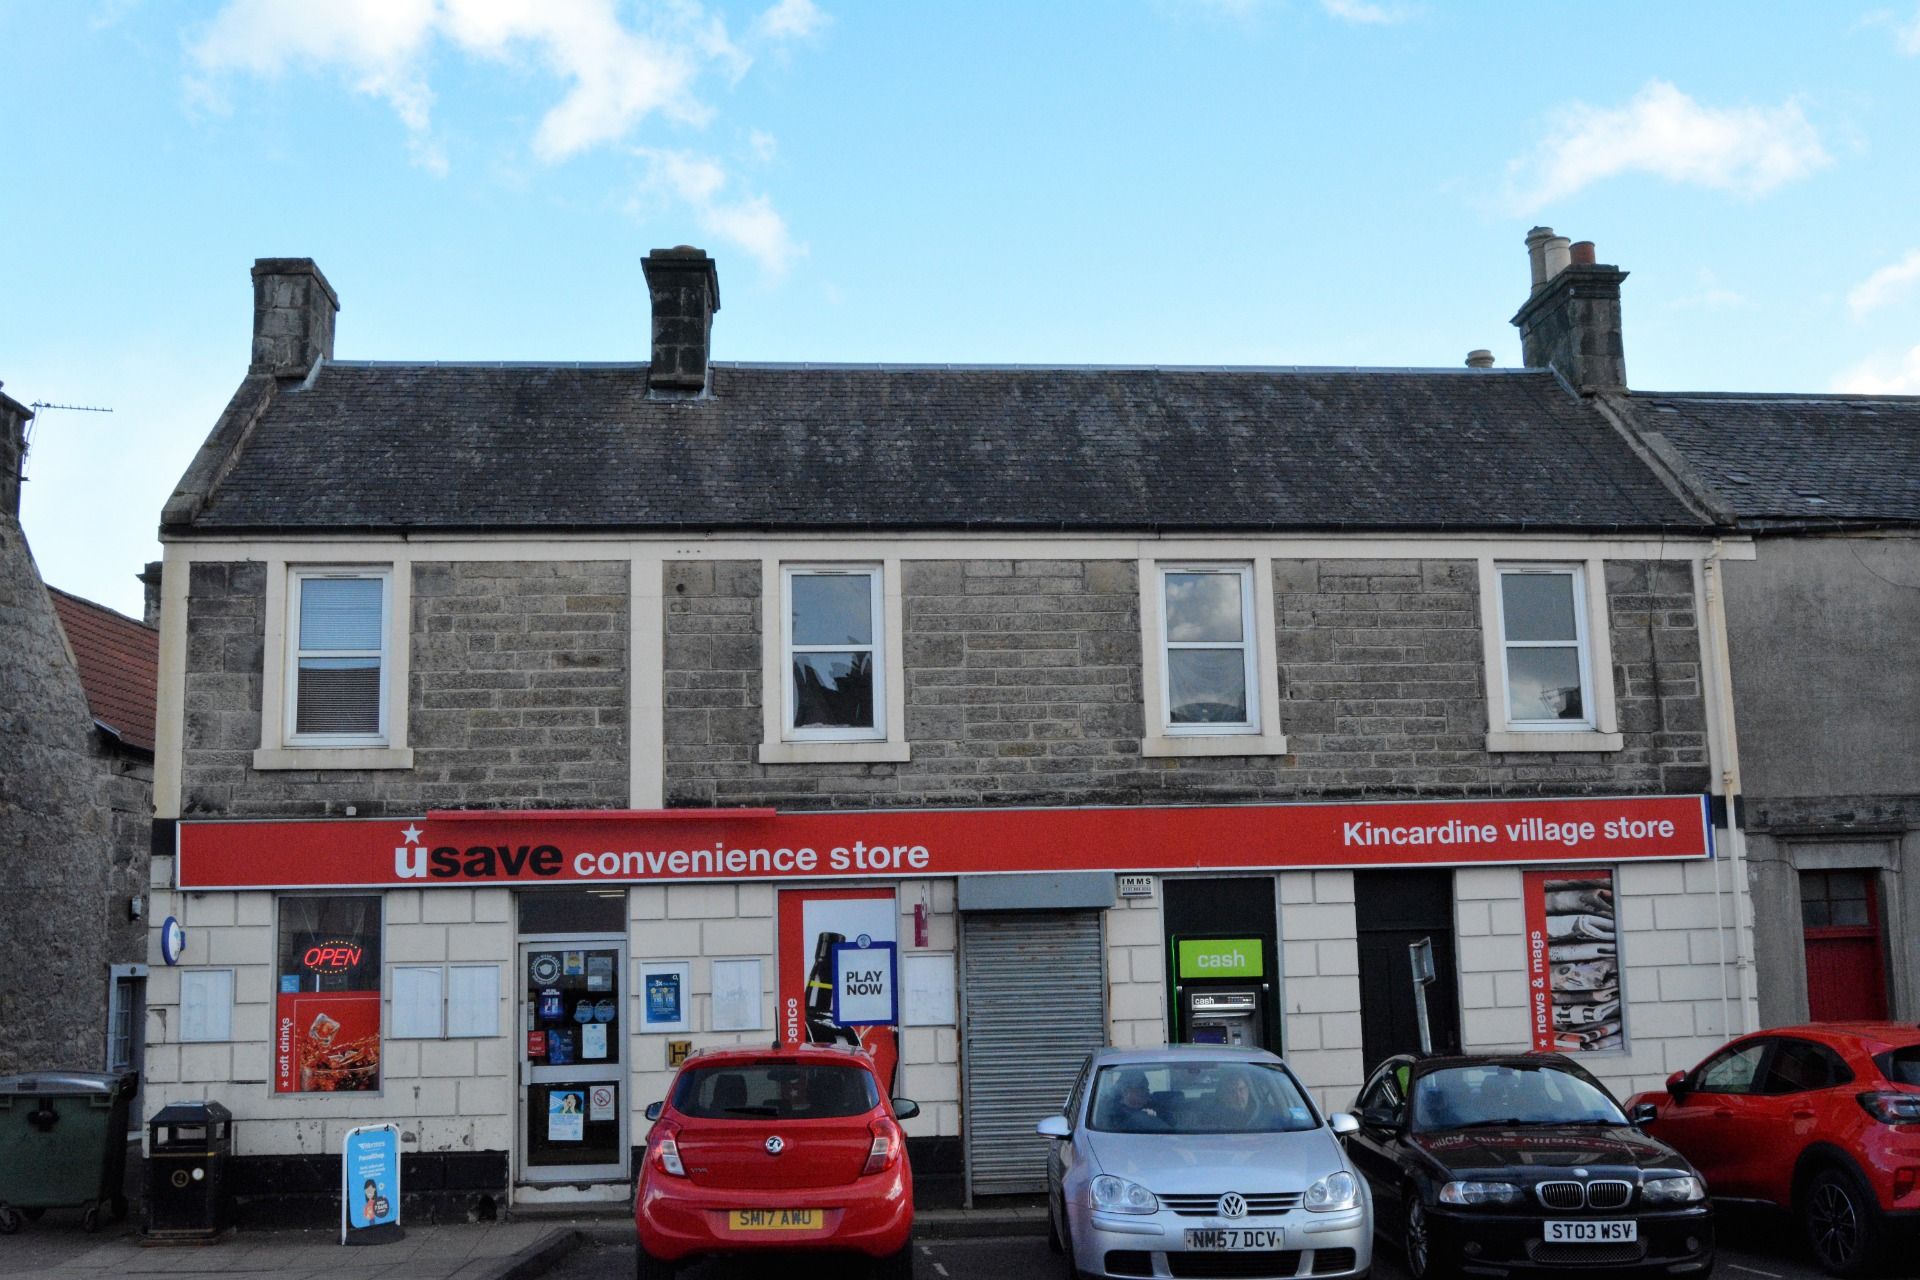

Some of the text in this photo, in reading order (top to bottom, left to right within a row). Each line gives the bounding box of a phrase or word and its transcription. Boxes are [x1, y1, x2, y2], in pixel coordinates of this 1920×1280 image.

[1343, 816, 1675, 846] Kincardine village store
[394, 840, 929, 878] usave convenience store
[304, 948, 362, 966] OPEN
[1197, 949, 1245, 968] cash
[846, 970, 883, 983] PLAY
[1531, 930, 1547, 1034] news & mags
[846, 983, 883, 996] NOW
[1194, 996, 1215, 1005] cash
[280, 1018, 290, 1077] soft drinks
[781, 1209, 812, 1225] AWU
[1193, 1231, 1276, 1248] NM57 DCV
[1601, 1223, 1632, 1239] WSV
